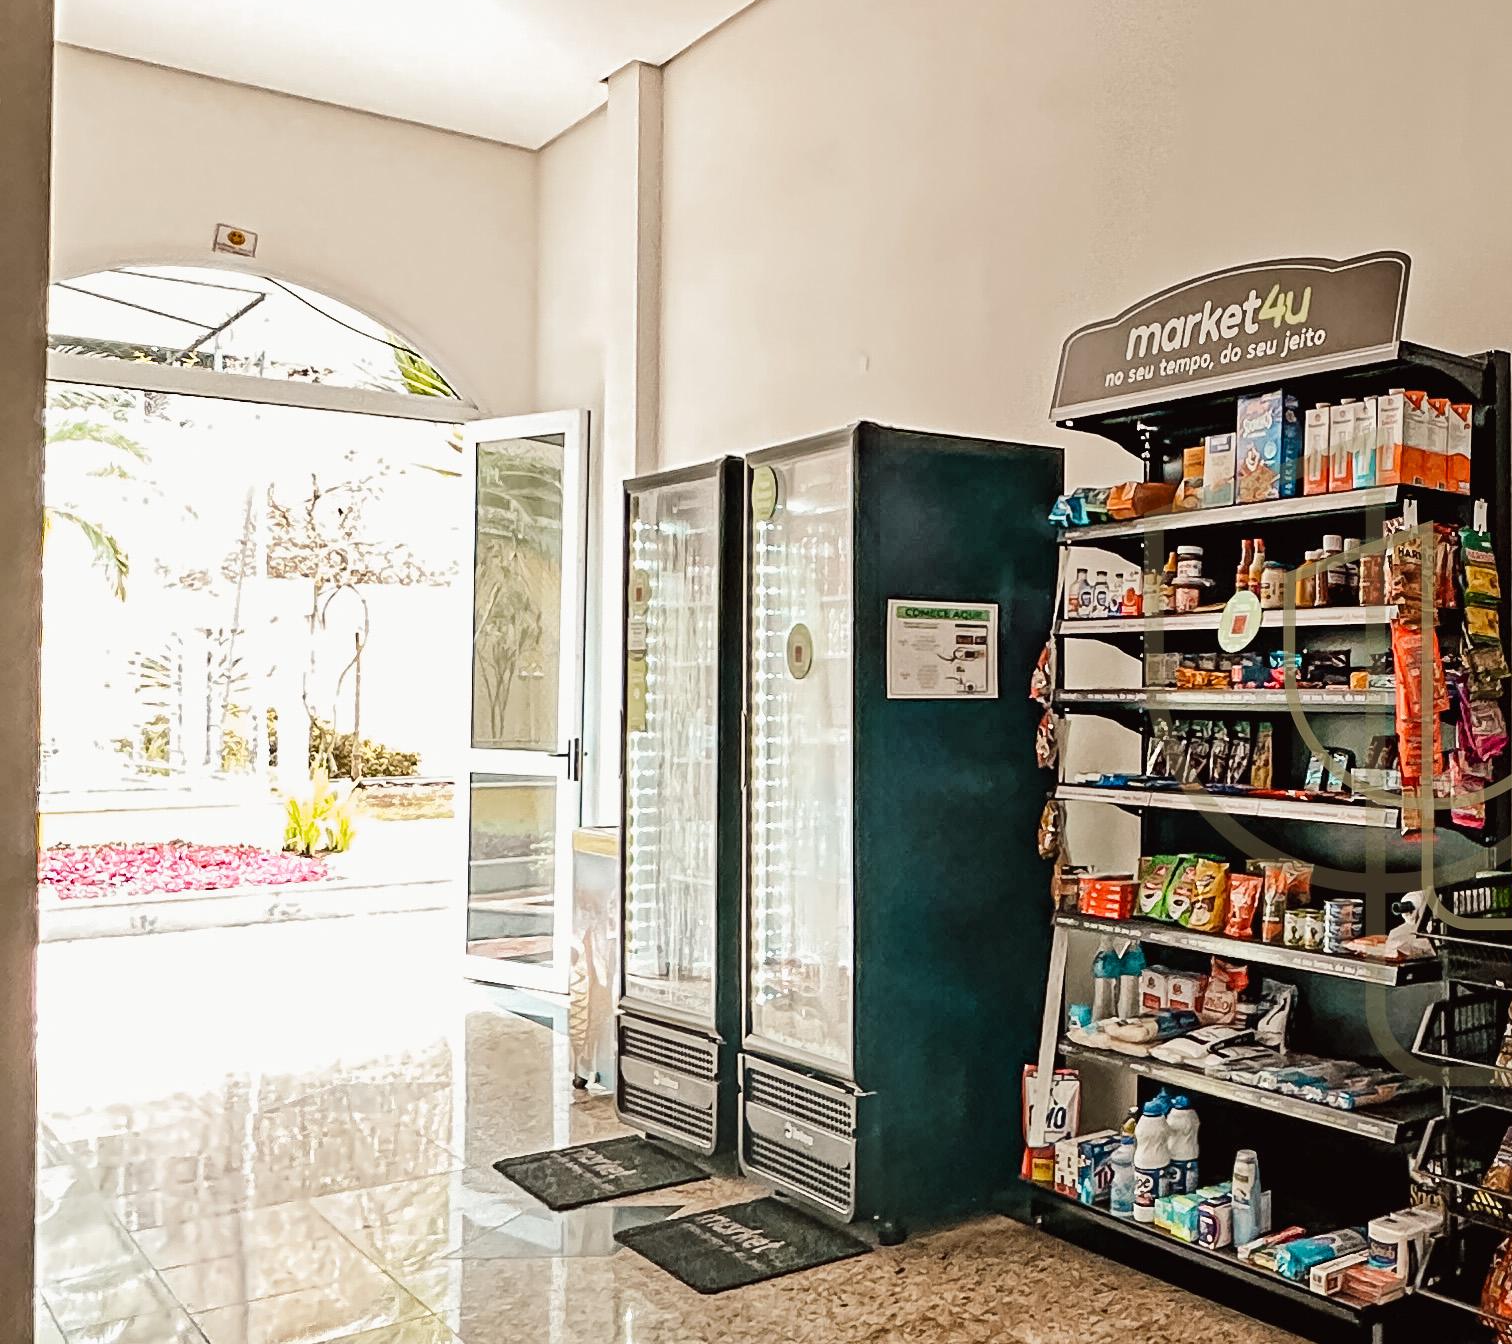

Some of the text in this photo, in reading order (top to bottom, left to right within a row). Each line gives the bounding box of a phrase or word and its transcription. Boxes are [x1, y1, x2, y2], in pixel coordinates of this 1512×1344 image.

[1126, 283, 1312, 360] market4u
[1105, 327, 1326, 387] no seu tempo, do seu jeito
